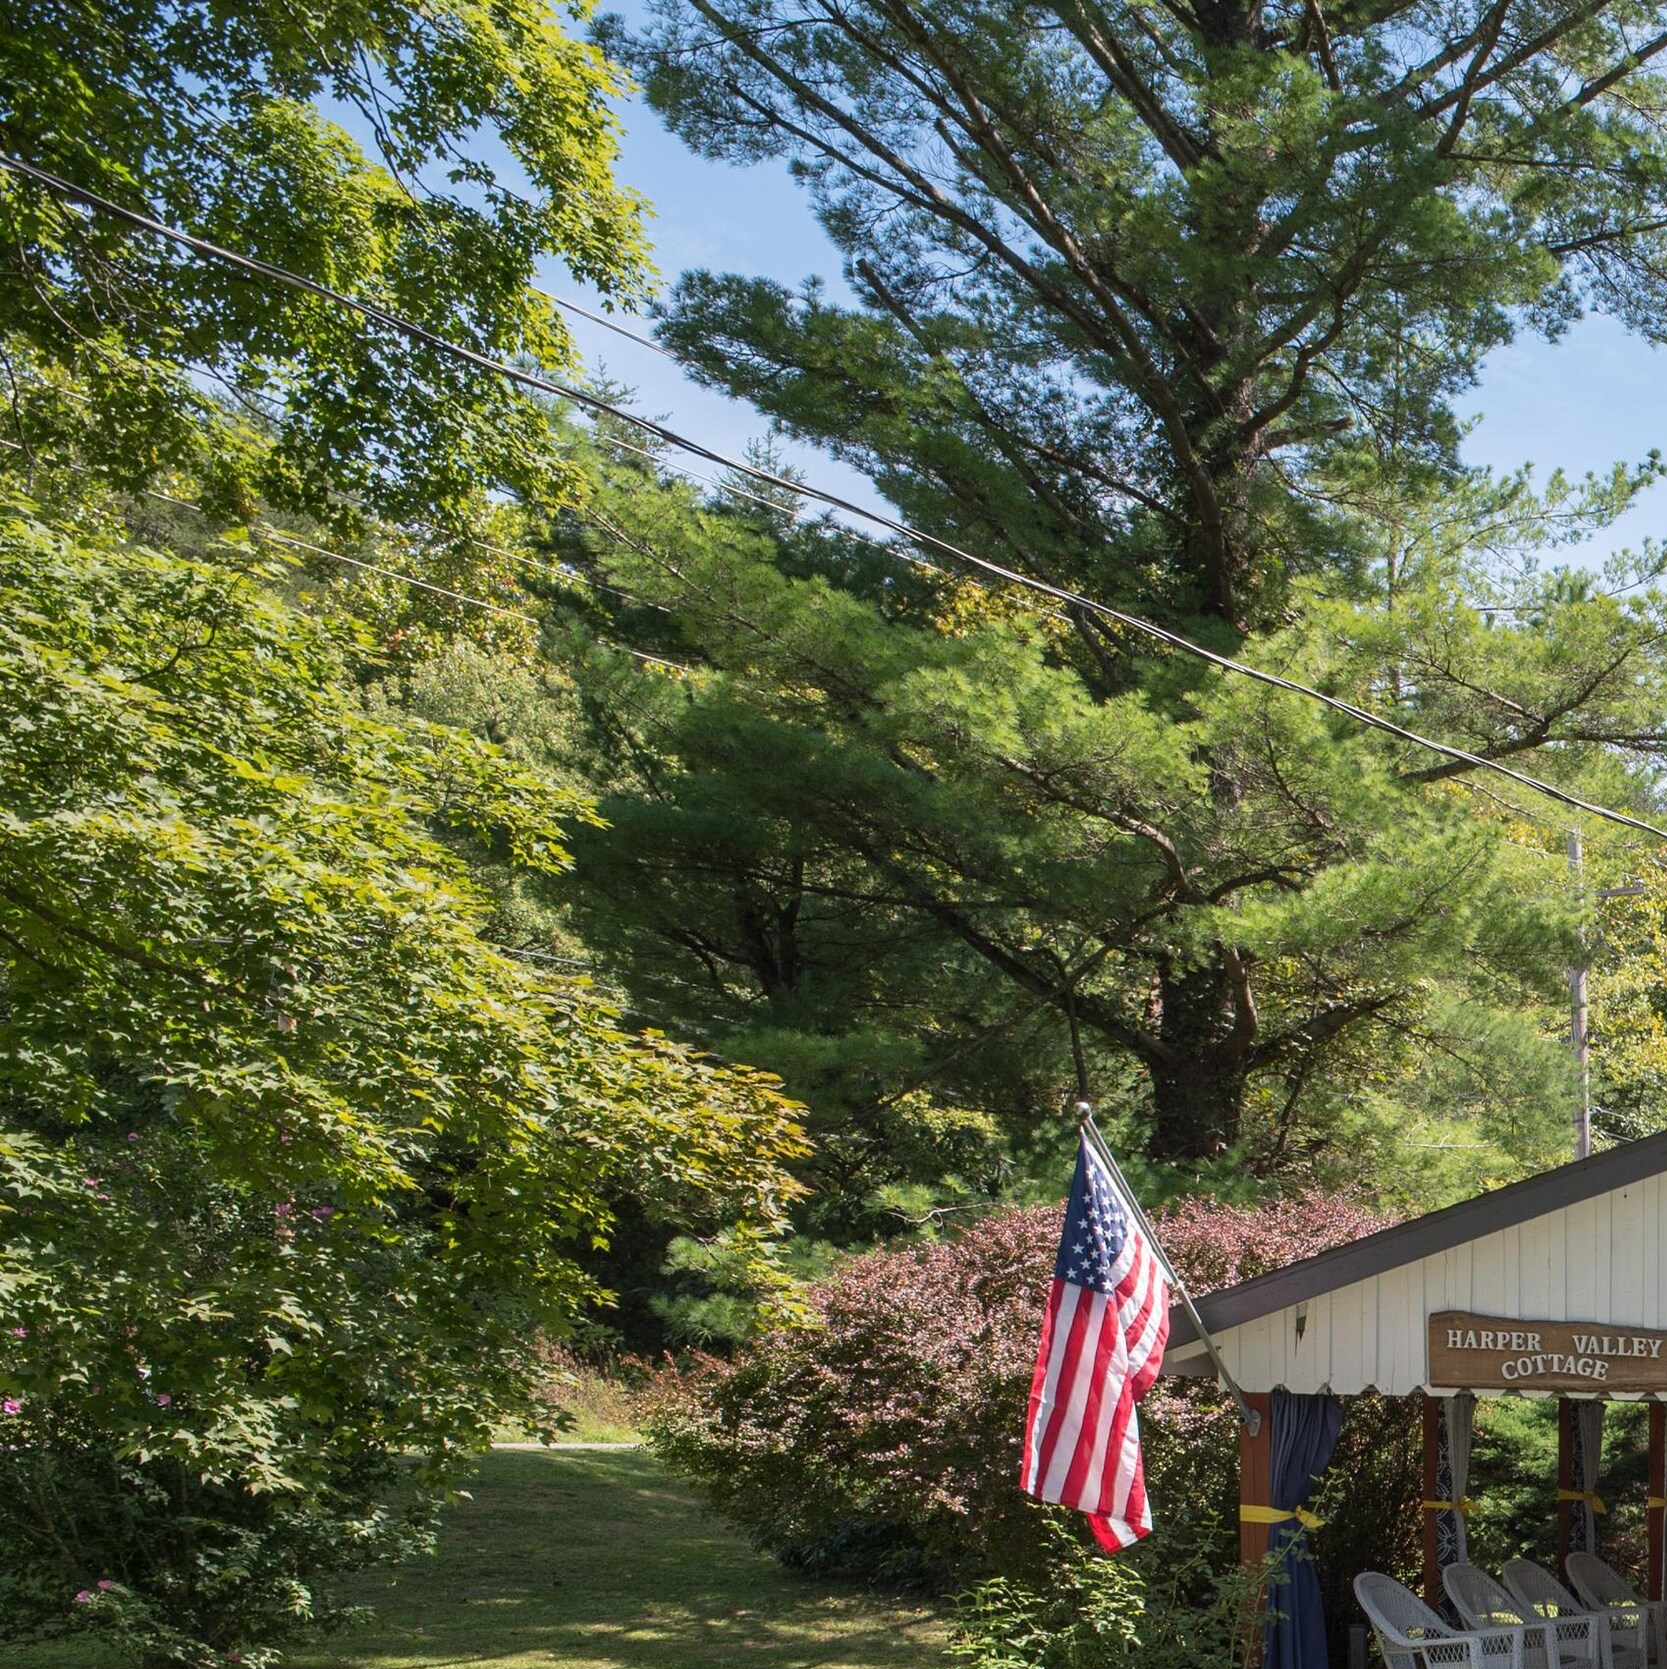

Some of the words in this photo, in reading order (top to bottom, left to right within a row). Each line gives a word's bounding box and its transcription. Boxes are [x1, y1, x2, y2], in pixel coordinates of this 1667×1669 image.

[1446, 1329, 1542, 1351] HARPER
[1572, 1334, 1664, 1358] VALLEY
[1501, 1354, 1610, 1381] COTTAGE
